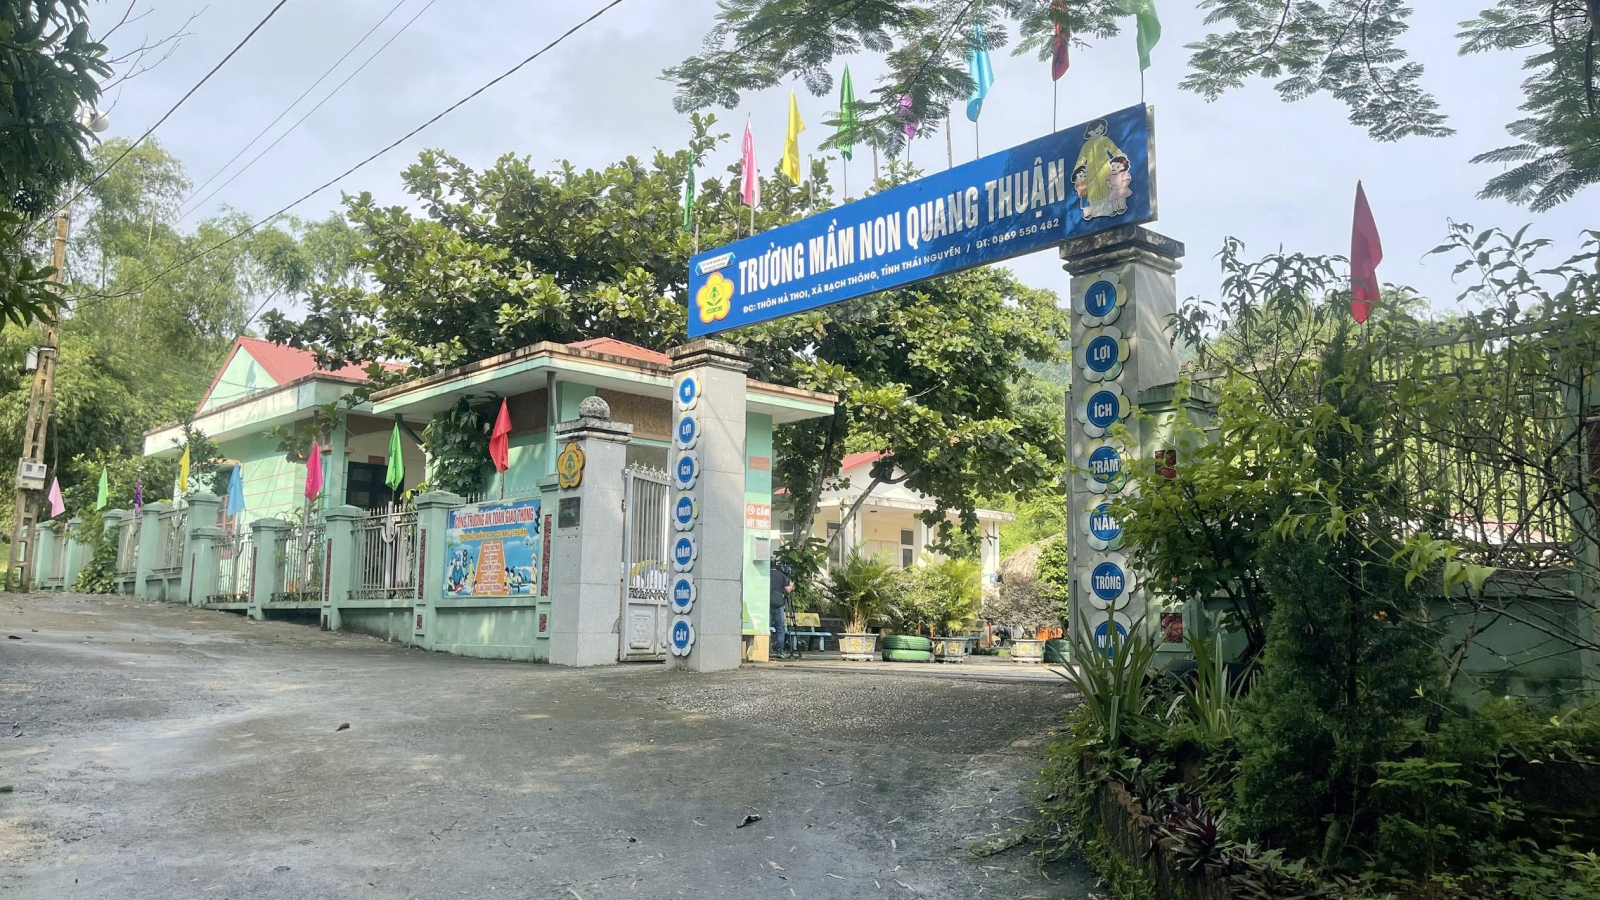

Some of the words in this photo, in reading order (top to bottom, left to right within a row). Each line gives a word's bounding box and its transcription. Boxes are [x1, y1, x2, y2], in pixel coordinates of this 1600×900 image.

[739, 242, 804, 296] TRƯỜNG
[809, 218, 854, 276] MẦM
[860, 211, 901, 261] NON
[907, 186, 978, 250] QUANG
[985, 156, 1065, 222] THUẬN
[743, 304, 756, 314] ĐC:
[757, 298, 777, 310] THÔN
[778, 292, 789, 305] NÀ
[811, 284, 823, 295] XÃ
[824, 278, 846, 293] BẠCH
[848, 271, 880, 285] THÔNG,
[881, 263, 900, 276] TỈNH
[902, 256, 922, 270] THÁI
[923, 246, 961, 265] NGUYÊN
[966, 243, 971, 253] /
[976, 239, 990, 249] ĐT:
[992, 231, 1017, 245] 0869
[1019, 224, 1038, 237] 550
[1040, 218, 1060, 231] 482
[1095, 290, 1107, 307] VÌ
[1093, 344, 1111, 363] LỢI
[1094, 403, 1112, 418] ÍCH
[682, 423, 691, 436] LỢI
[681, 464, 691, 475] ÍCH
[1091, 456, 1119, 474] TRĂM
[485, 511, 492, 526] AN
[492, 508, 505, 525] TOÀN
[505, 509, 517, 523] GIAO
[517, 505, 534, 521] THÔNG
[677, 546, 690, 558] NĂM
[675, 629, 688, 641] CÂY
